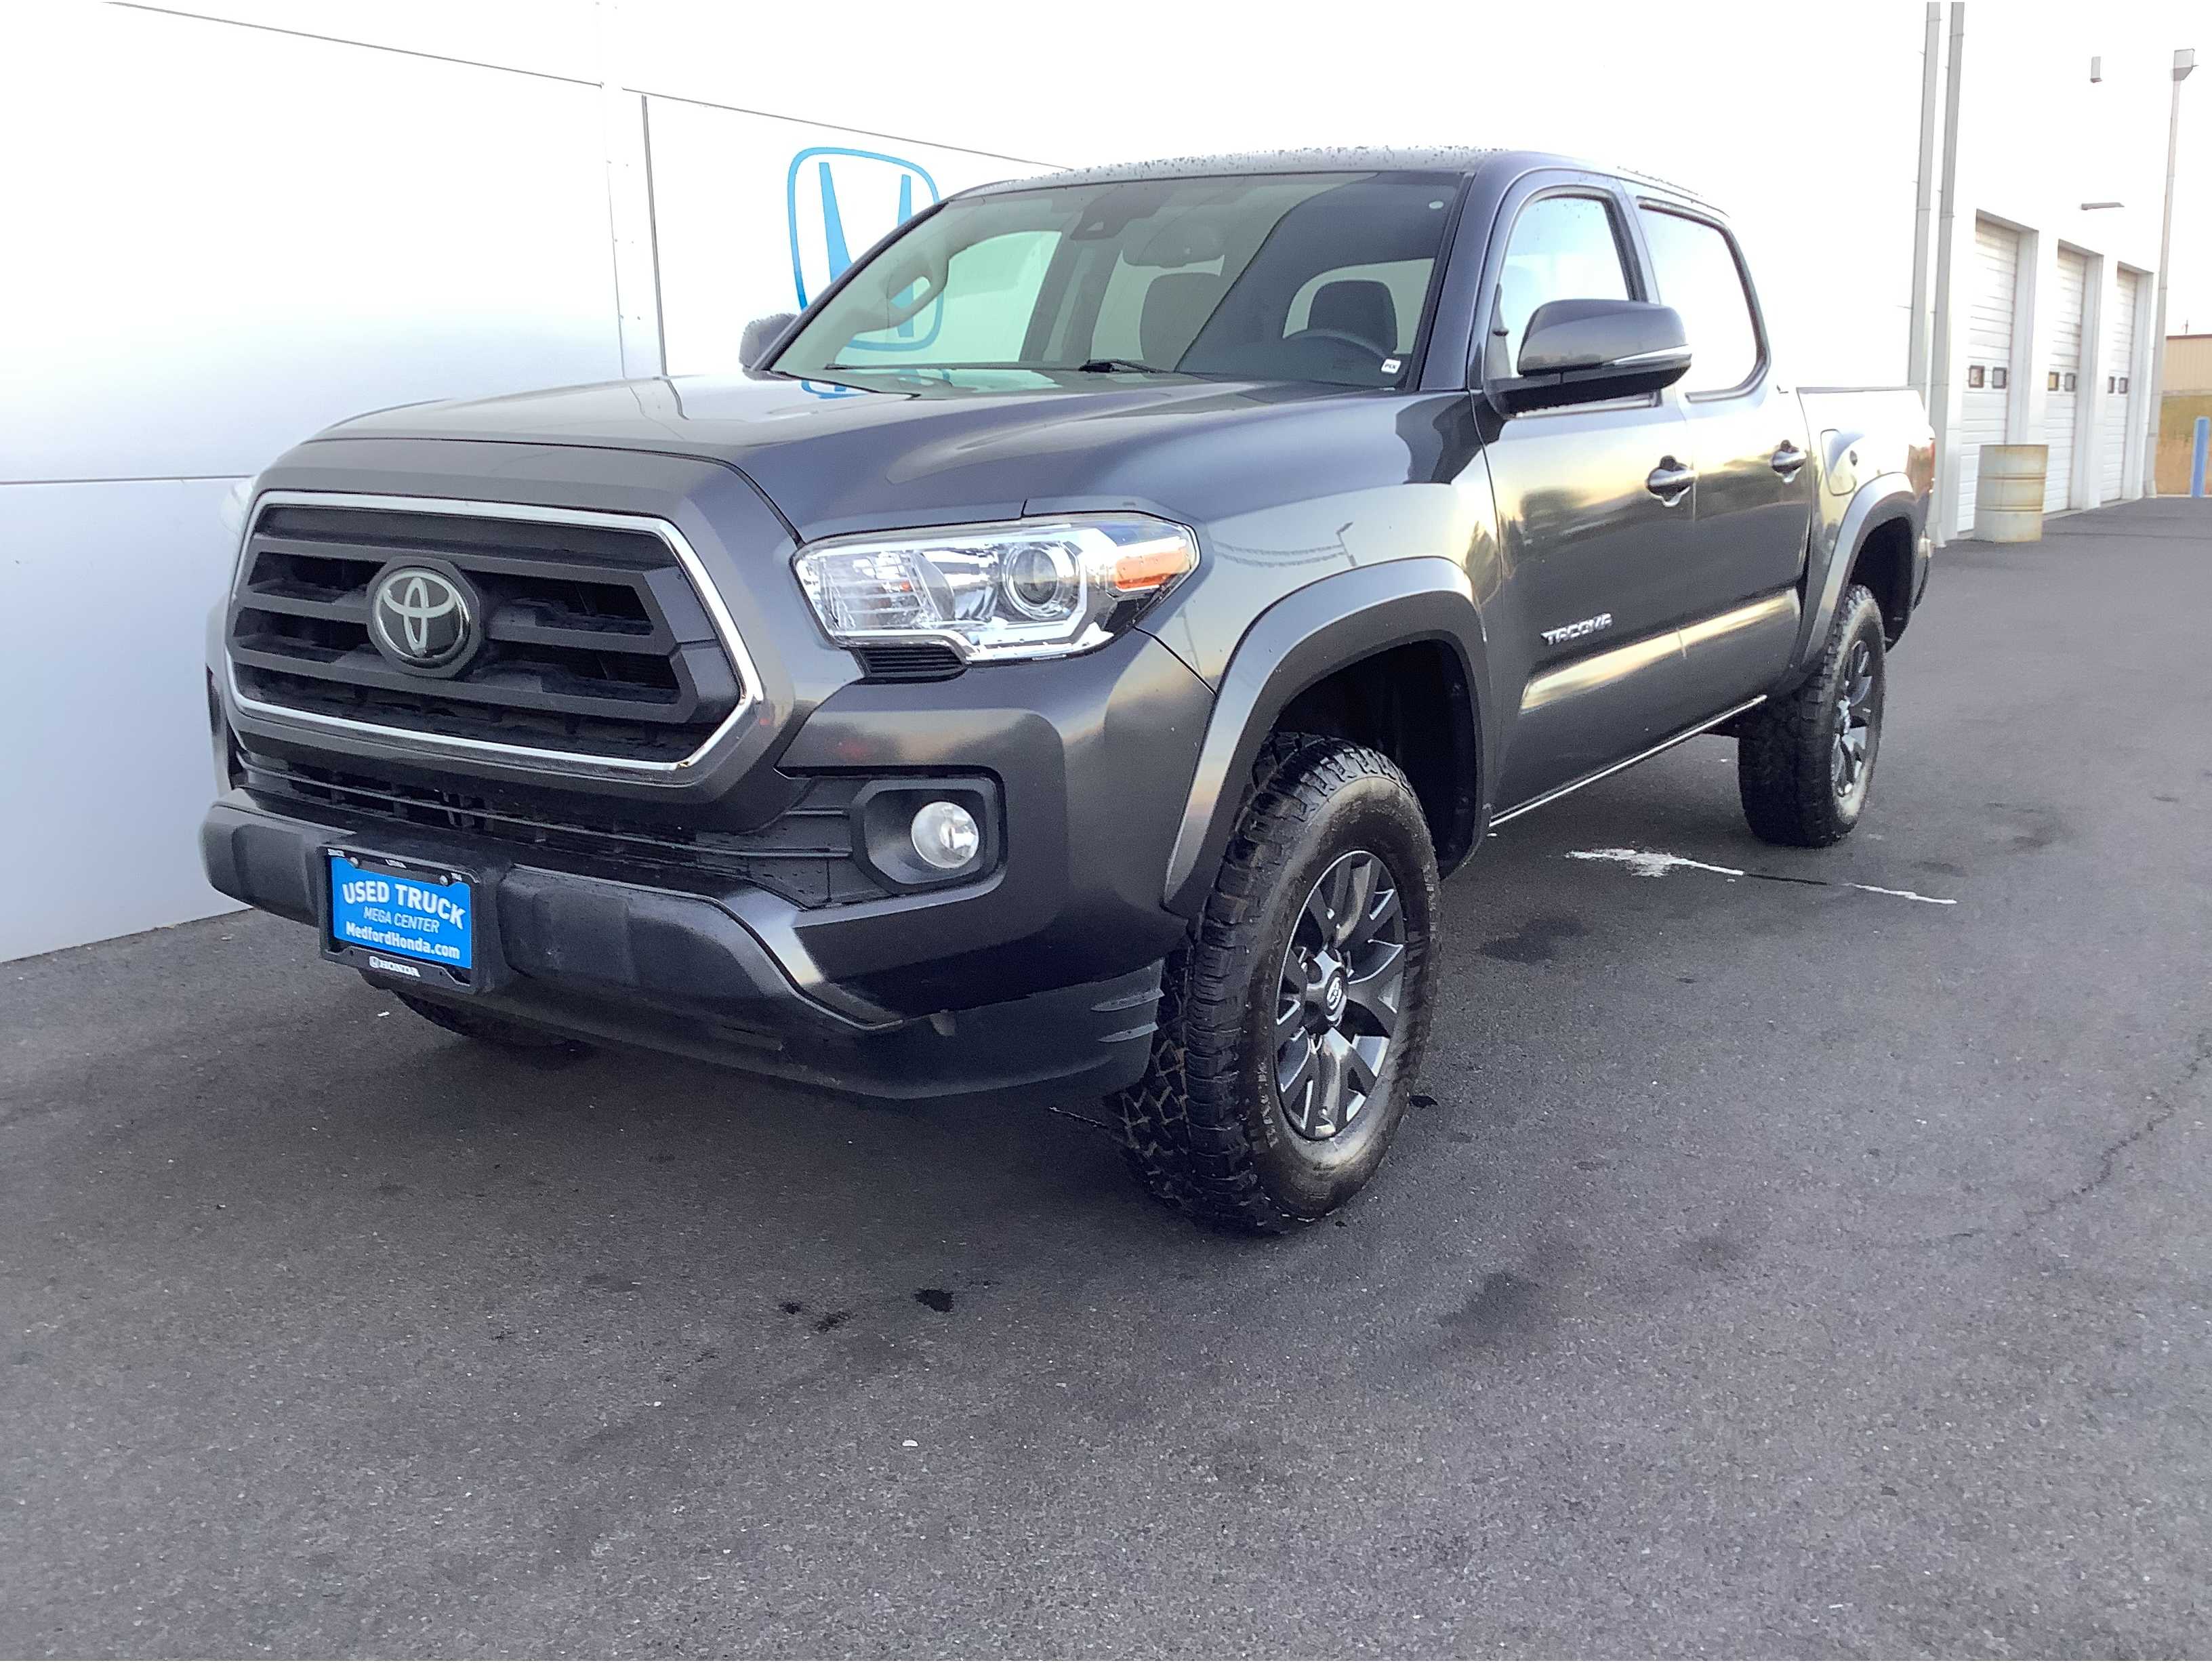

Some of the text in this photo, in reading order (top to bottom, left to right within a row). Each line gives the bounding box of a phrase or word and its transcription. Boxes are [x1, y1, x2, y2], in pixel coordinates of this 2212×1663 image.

[1541, 613, 1613, 645] TACOMA
[342, 880, 466, 930] USED TRUCK
[363, 906, 441, 934] MEGA CENTER
[346, 920, 461, 960] MedfordHonda.com
[379, 960, 422, 978] HONDA
